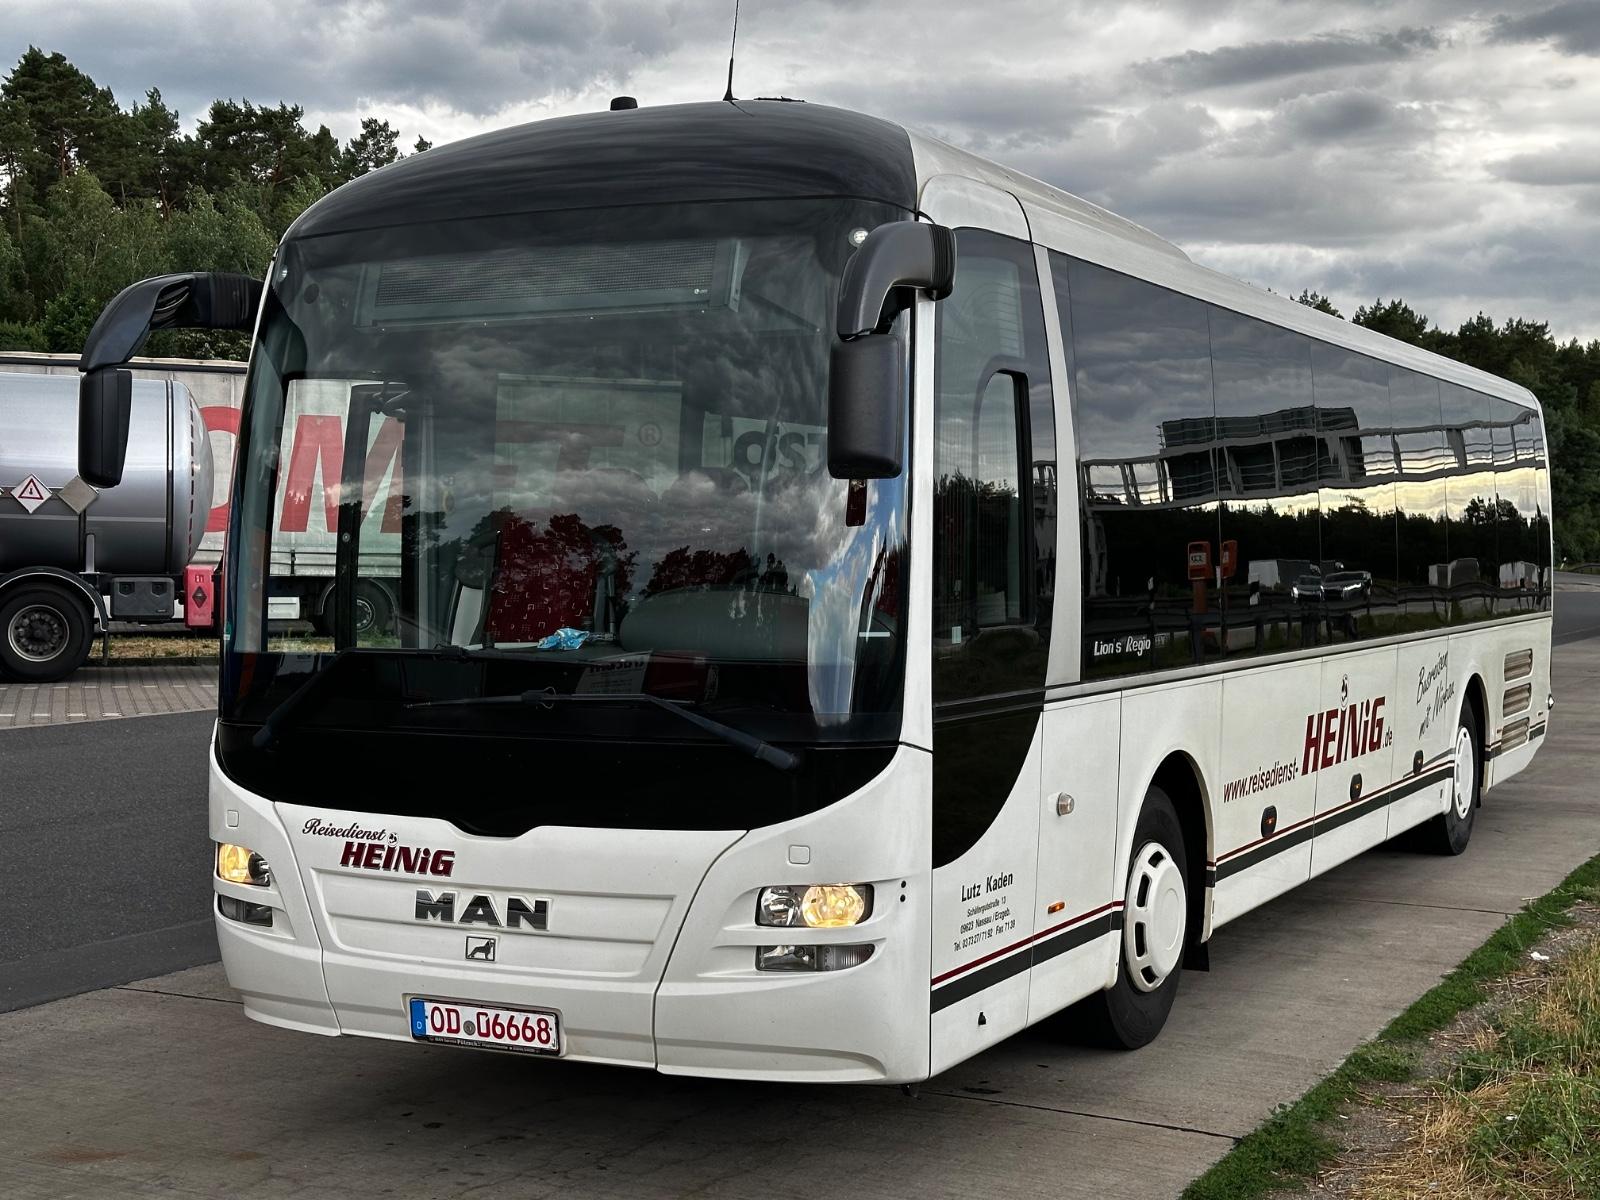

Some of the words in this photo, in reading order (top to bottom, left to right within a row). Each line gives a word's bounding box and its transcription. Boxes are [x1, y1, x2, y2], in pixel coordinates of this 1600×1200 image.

[1093, 640, 1122, 656] Lion's
[1125, 635, 1151, 656] Regio
[302, 818, 386, 841] Reisedienst
[961, 884, 981, 902] Lutz
[986, 872, 1013, 893] Kaden
[413, 888, 550, 932] MAN
[430, 1006, 461, 1034] OD
